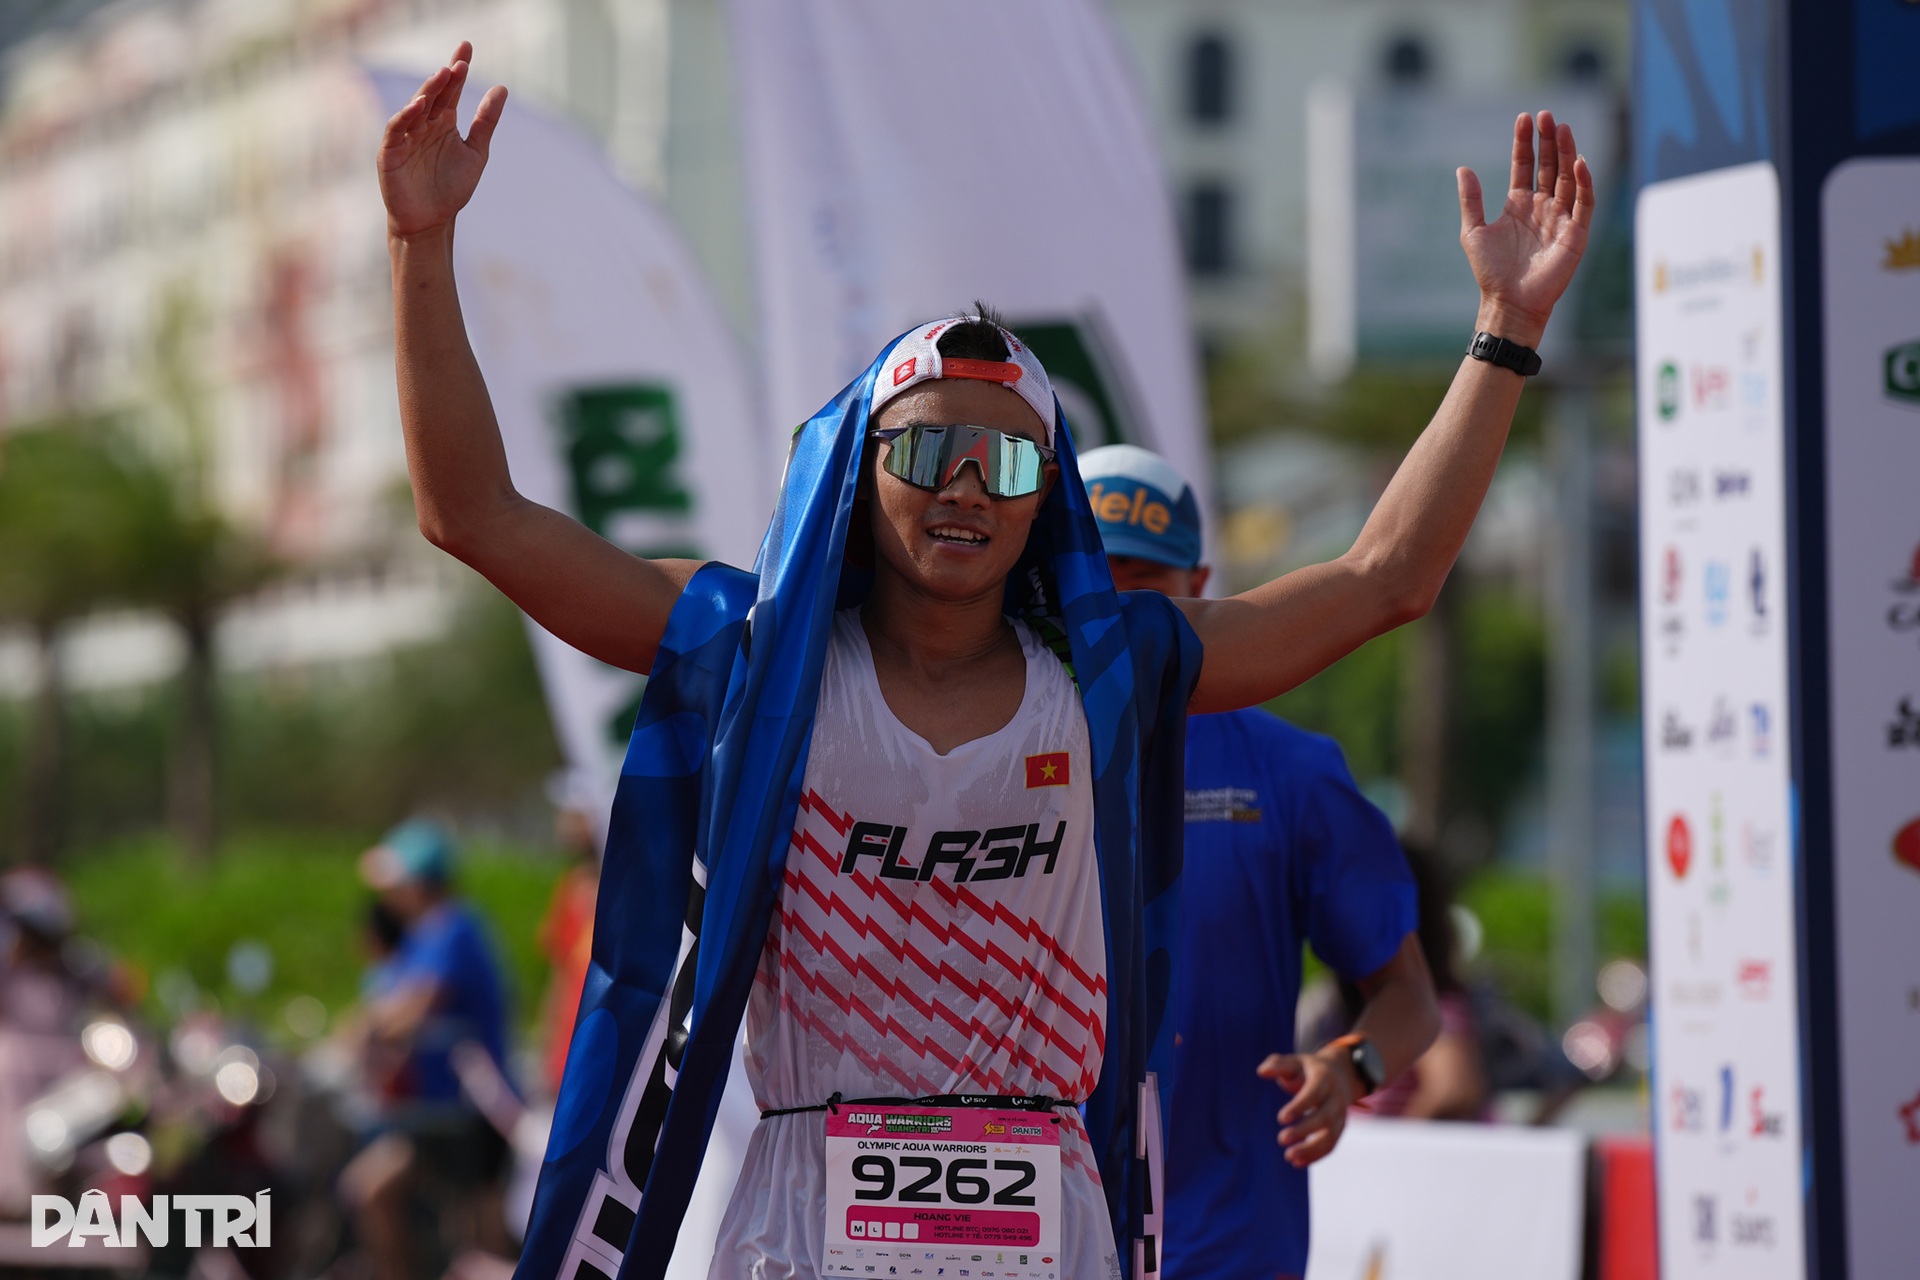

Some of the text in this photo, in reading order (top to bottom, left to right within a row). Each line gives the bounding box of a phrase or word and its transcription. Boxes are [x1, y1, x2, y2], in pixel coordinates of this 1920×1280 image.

[840, 820, 1067, 882] FLASH
[847, 1113, 952, 1127] AQUA WARRIORS
[857, 1141, 900, 1151] OLYMPIC
[902, 1142, 931, 1152] AQUA
[932, 1143, 987, 1154] WARRIORS
[851, 1155, 1036, 1206] 9262
[914, 1212, 971, 1222] HOANG VIE
[853, 1225, 863, 1233] M
